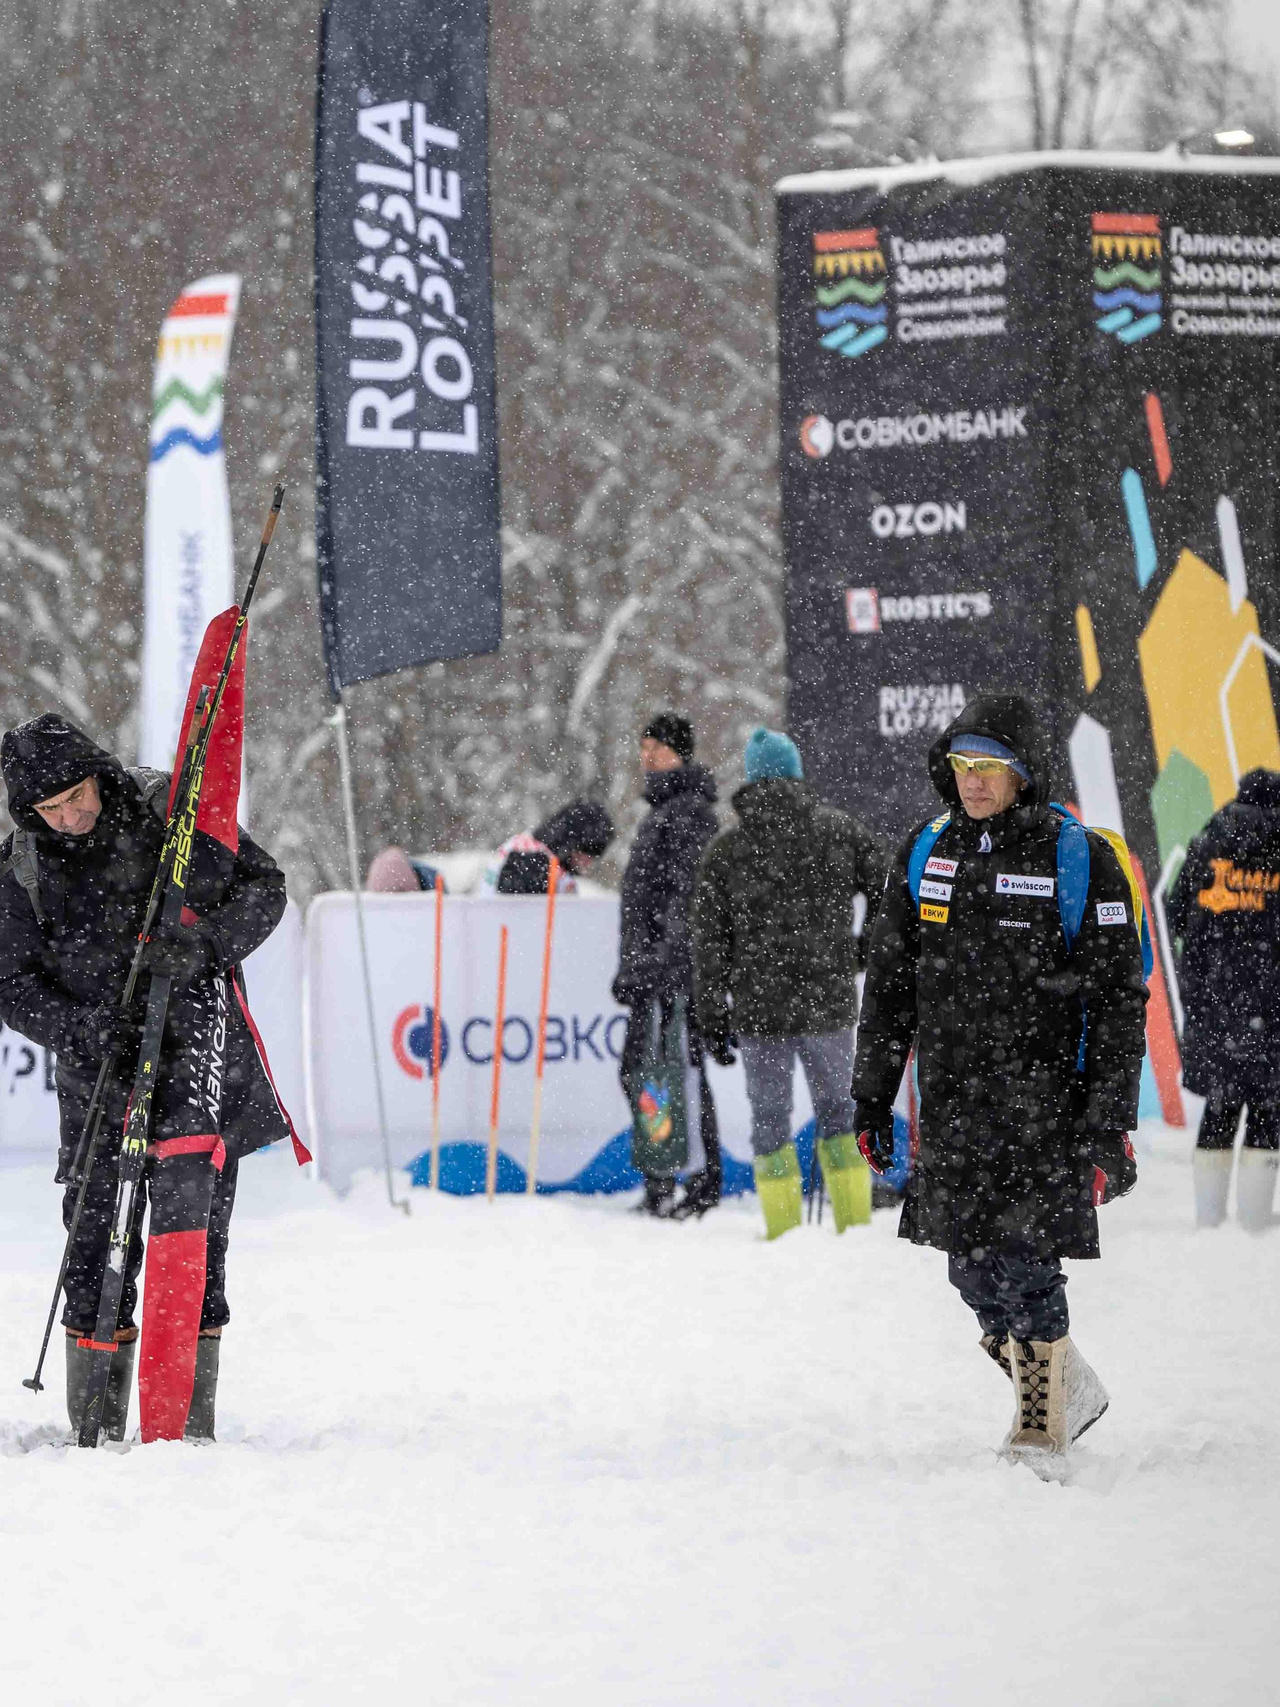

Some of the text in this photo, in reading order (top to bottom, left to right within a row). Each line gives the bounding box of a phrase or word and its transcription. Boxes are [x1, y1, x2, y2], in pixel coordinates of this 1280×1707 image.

[346, 100, 416, 450] RUSSIA
[413, 101, 480, 455] LOPPET
[894, 263, 1007, 295] Заозерье
[836, 407, 1028, 451] СОВКОМБАНК
[871, 501, 966, 538] OZON
[1011, 880, 1051, 892] swisscom
[927, 908, 945, 919] BKW
[999, 920, 1031, 929] DESCENTE
